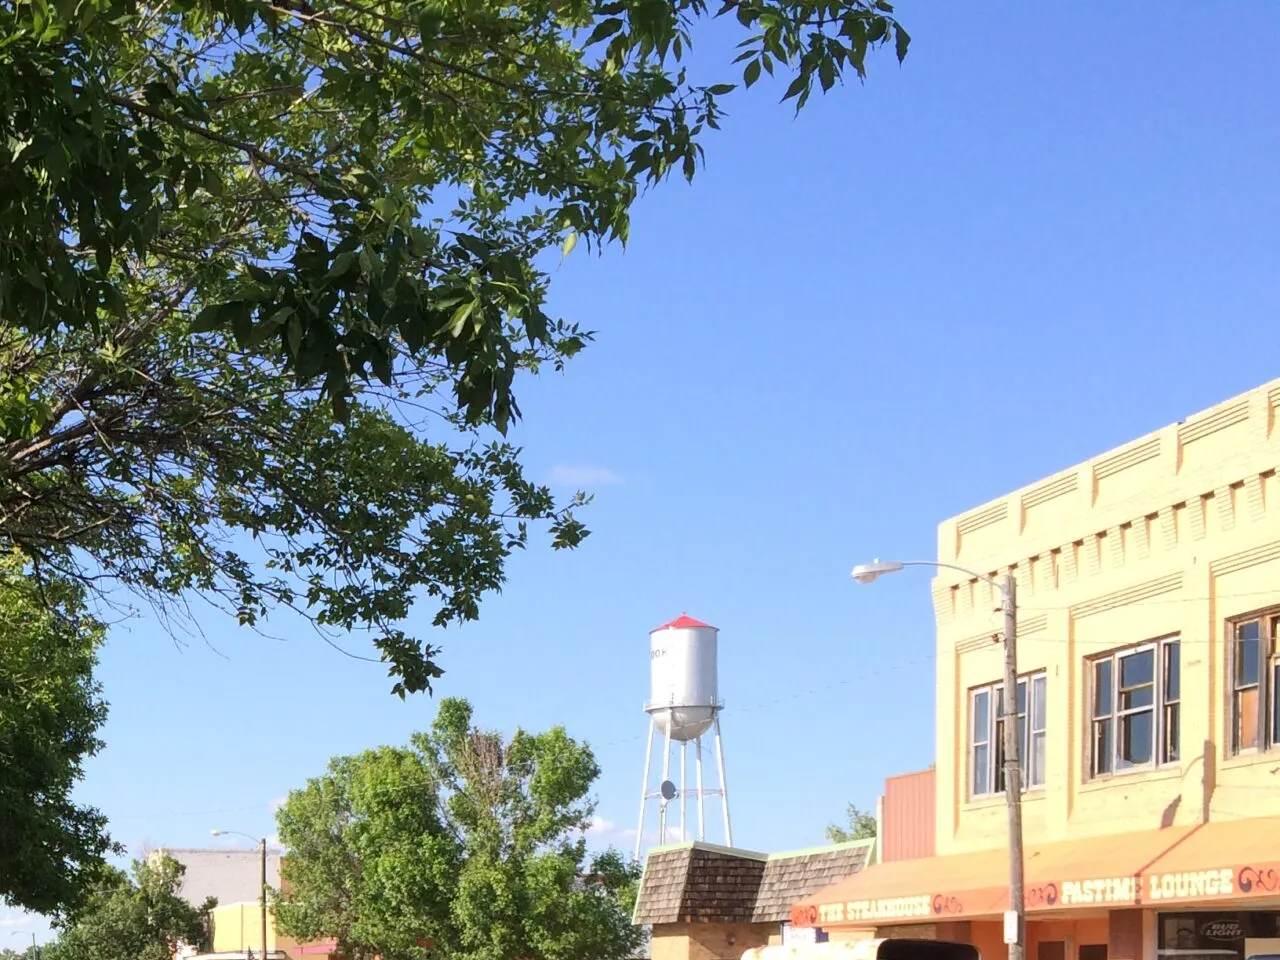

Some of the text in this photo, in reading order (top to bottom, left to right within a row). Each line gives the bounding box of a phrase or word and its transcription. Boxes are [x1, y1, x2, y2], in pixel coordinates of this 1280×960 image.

[1061, 868, 1234, 905] PASTIME LOUNGE
[819, 894, 932, 923] THE STEAKHOUSE
[1206, 929, 1242, 937] LIGHT
